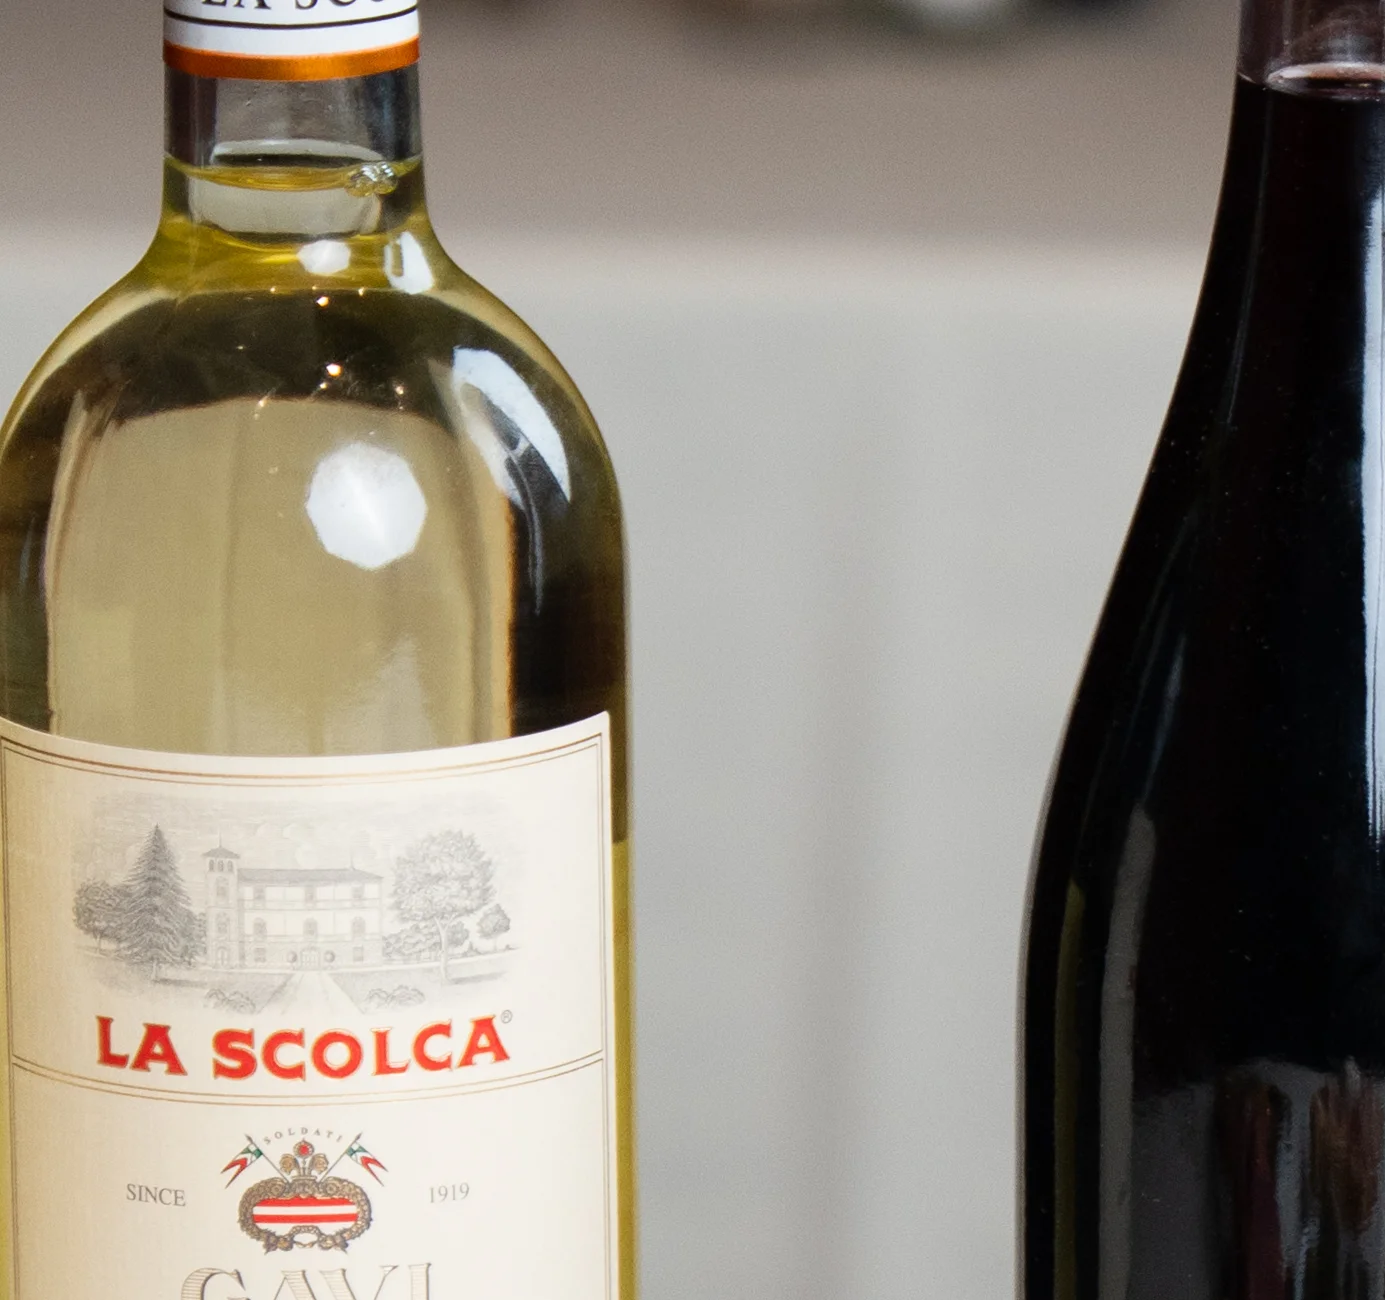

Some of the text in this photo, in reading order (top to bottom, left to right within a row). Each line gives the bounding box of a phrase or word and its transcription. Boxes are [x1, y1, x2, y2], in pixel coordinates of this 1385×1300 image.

[96, 1015, 188, 1075] LA
[264, 1127, 343, 1144] SOLDATI
[126, 1182, 470, 1206] SINCE 1919
